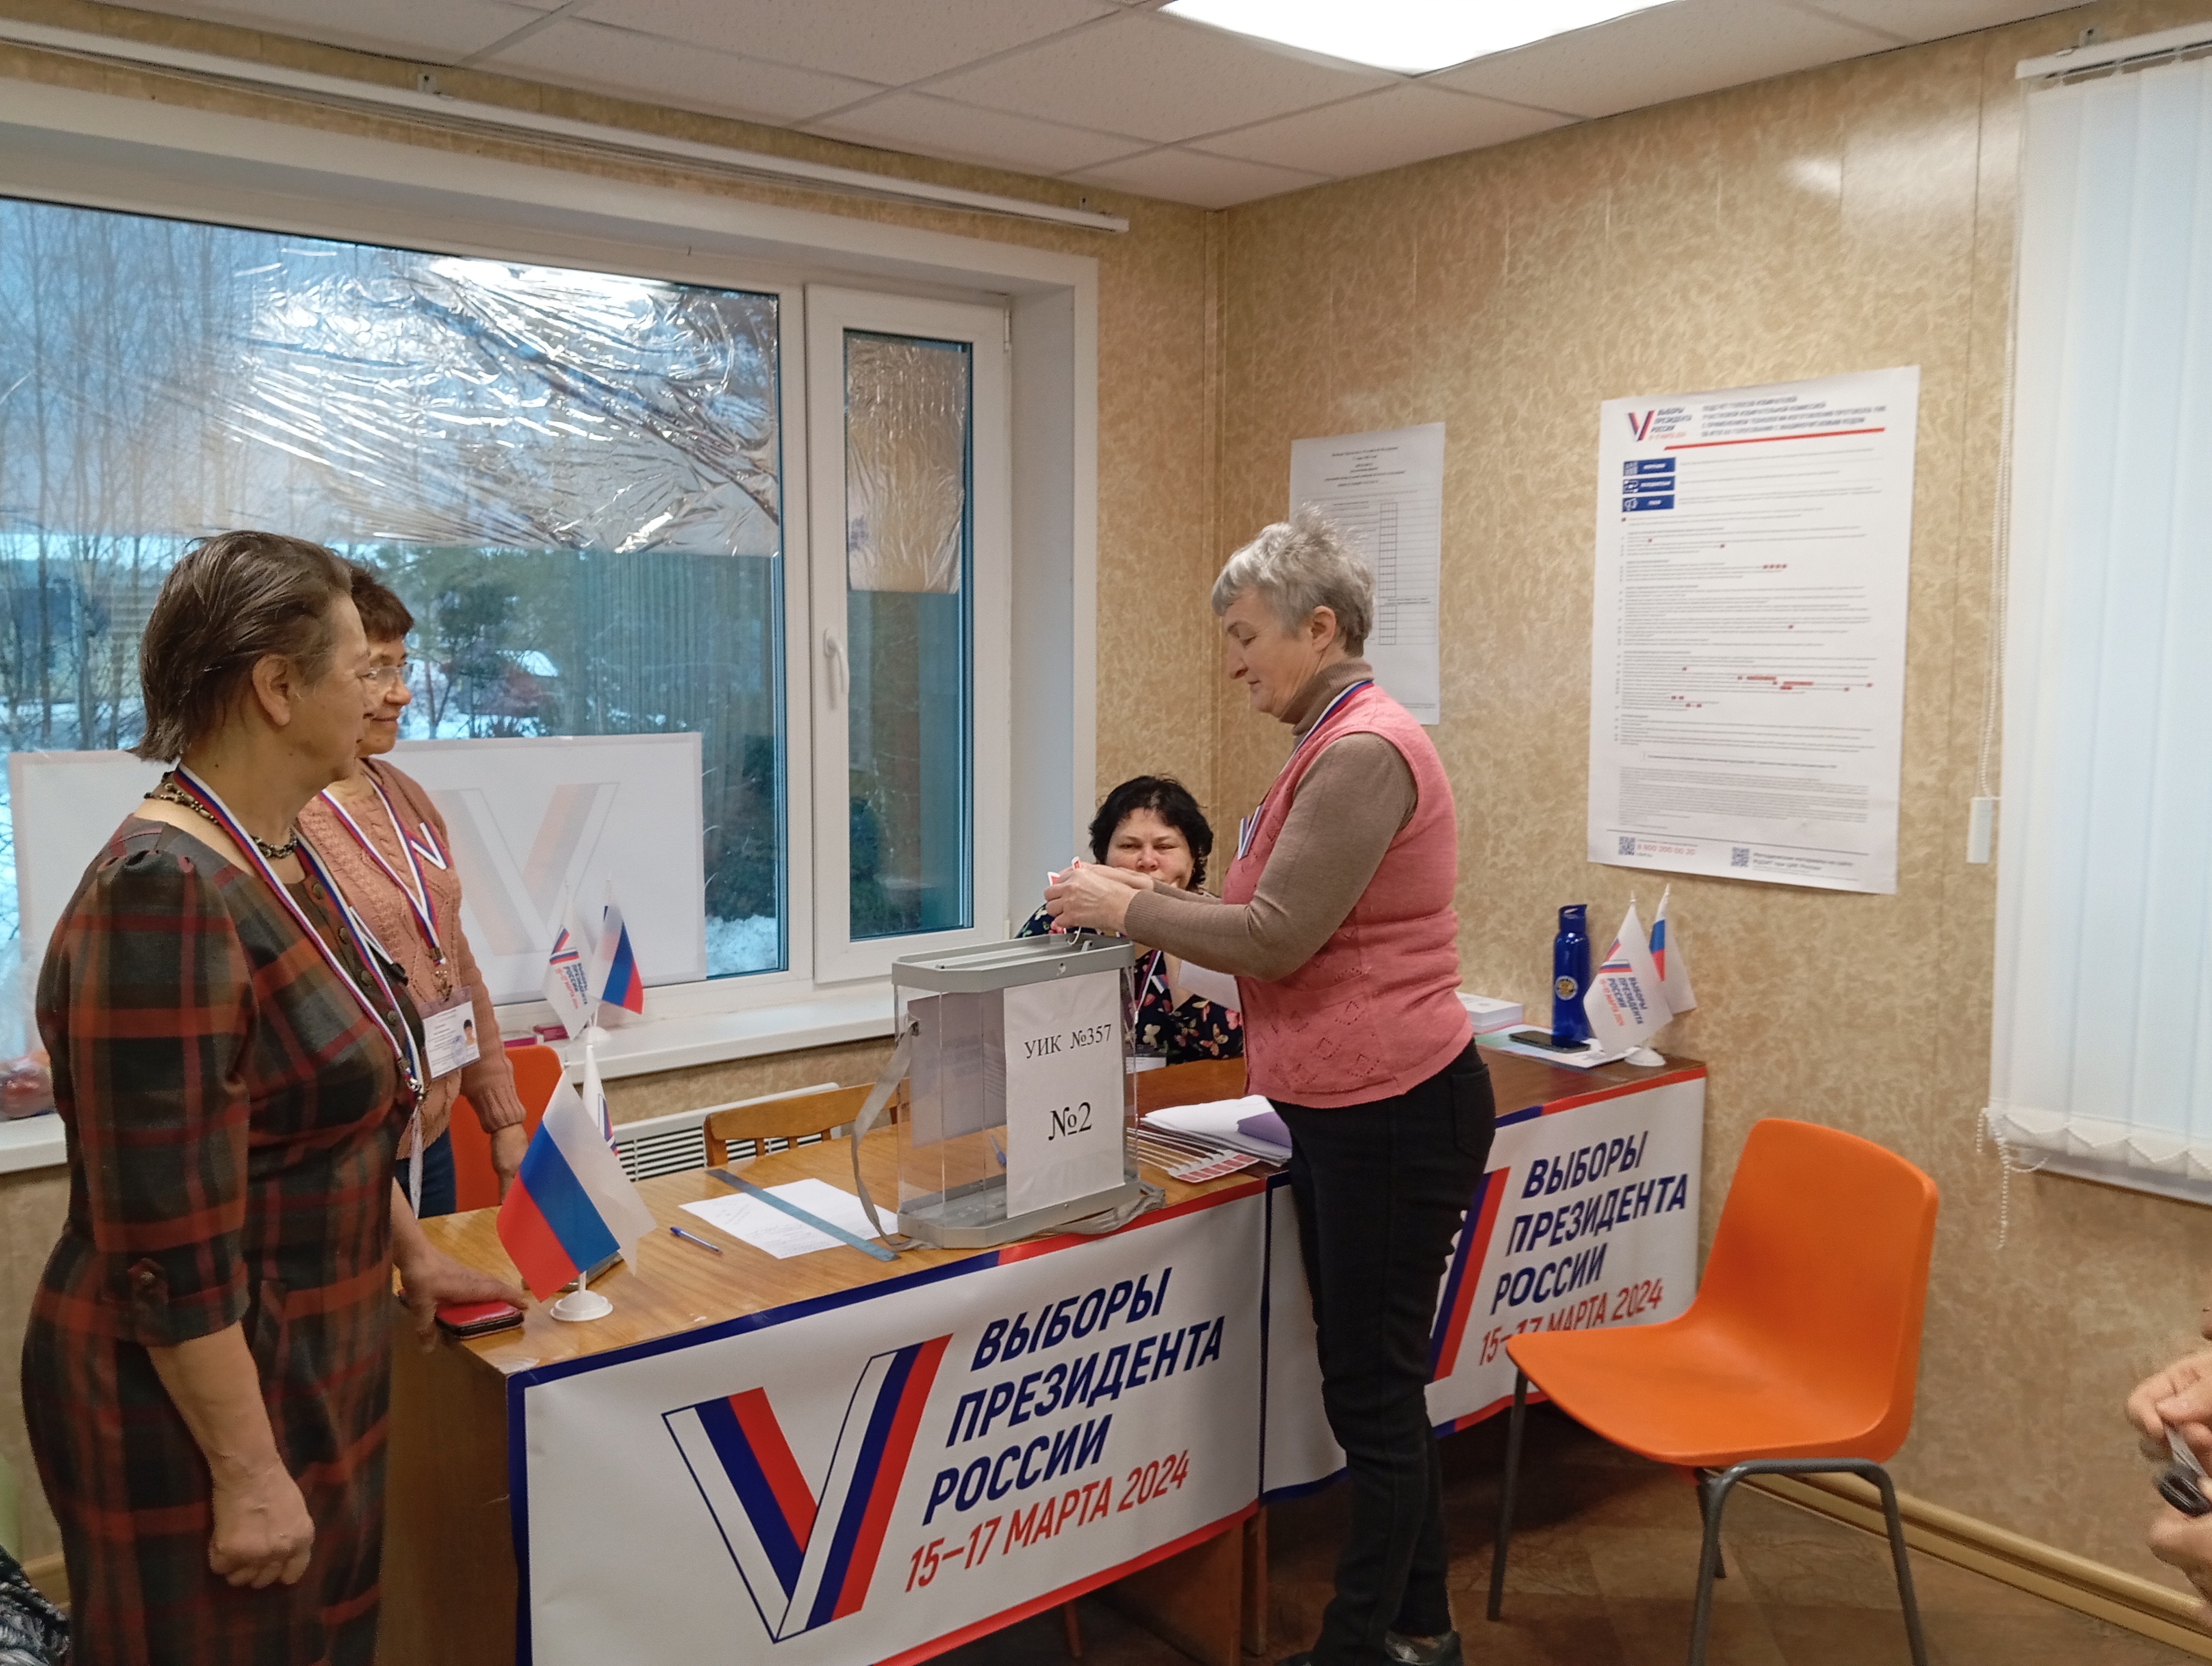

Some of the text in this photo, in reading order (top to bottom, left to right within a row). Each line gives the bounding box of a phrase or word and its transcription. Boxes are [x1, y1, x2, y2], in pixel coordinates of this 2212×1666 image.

[1024, 1023, 1111, 1059] УИК №357
[1048, 1101, 1092, 1140] №2
[1521, 1130, 1649, 1199] ВЫБОРЫ
[1505, 1174, 1689, 1257] ПРЕЗИДЕНТА
[1490, 1242, 1608, 1316] РОССИИ
[1611, 1278, 1663, 1321] 2024
[970, 1267, 1172, 1372] ВЫБОРЫ
[946, 1315, 1225, 1448] ПРЕЗИДЕНТА
[922, 1413, 1114, 1526] РОССИИ
[1002, 1476, 1114, 1555] МАРТА
[1116, 1449, 1190, 1513] 2024
